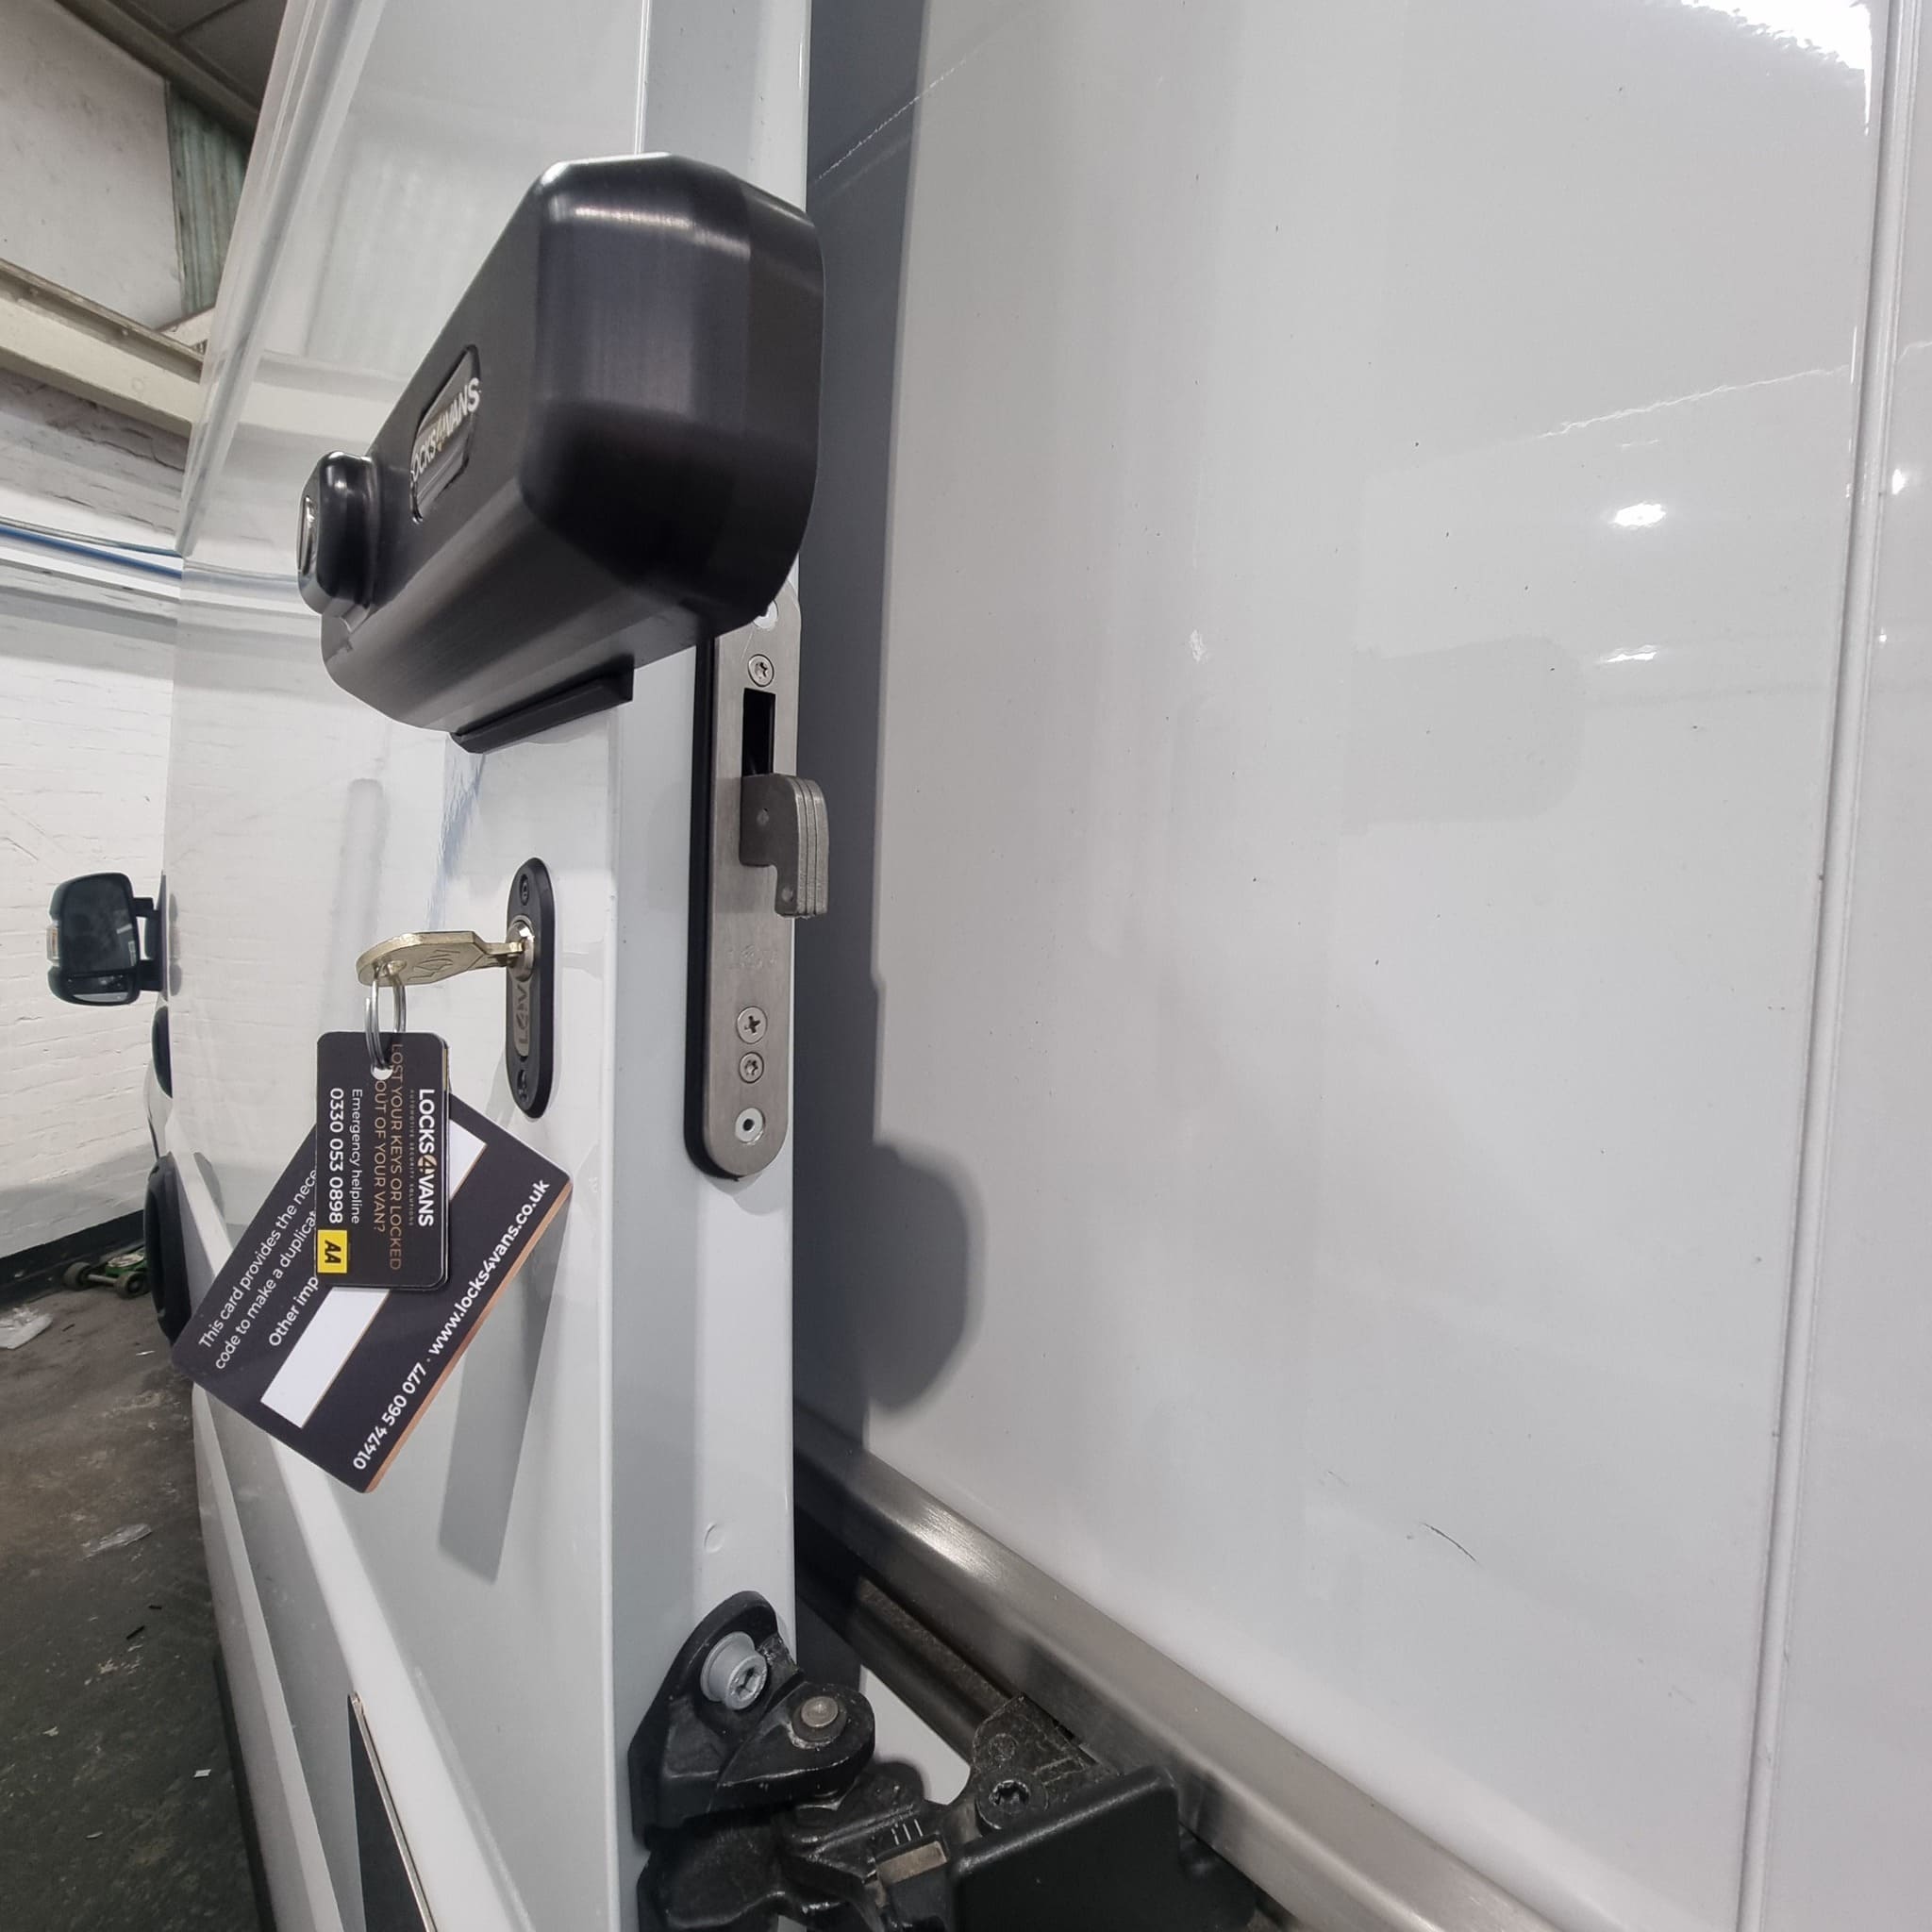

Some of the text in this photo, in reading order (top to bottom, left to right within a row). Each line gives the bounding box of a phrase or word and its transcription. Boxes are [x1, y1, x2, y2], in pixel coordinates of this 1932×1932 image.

[410, 377, 481, 484] OCKS4VANS
[329, 1088, 344, 1224] 0330 053 0898
[349, 1089, 362, 1224] Emergency helpline
[374, 1080, 387, 1233] OUT OF YOUR VAN?
[390, 1043, 403, 1270] LOST YOUR KEYS OR LOCKED
[418, 1089, 437, 1226] LOCKS4VANS
[198, 1319, 225, 1348] This
[220, 1286, 244, 1321] card
[240, 1229, 282, 1291] provides
[275, 1204, 297, 1230] the
[215, 1335, 242, 1370] code
[235, 1319, 251, 1335] to
[247, 1279, 276, 1320] make
[273, 1268, 284, 1279] a
[325, 1240, 341, 1264] AA
[268, 1305, 300, 1347] Other
[352, 1178, 551, 1471] 01474 560 077 www.locks4vans.co.uk
